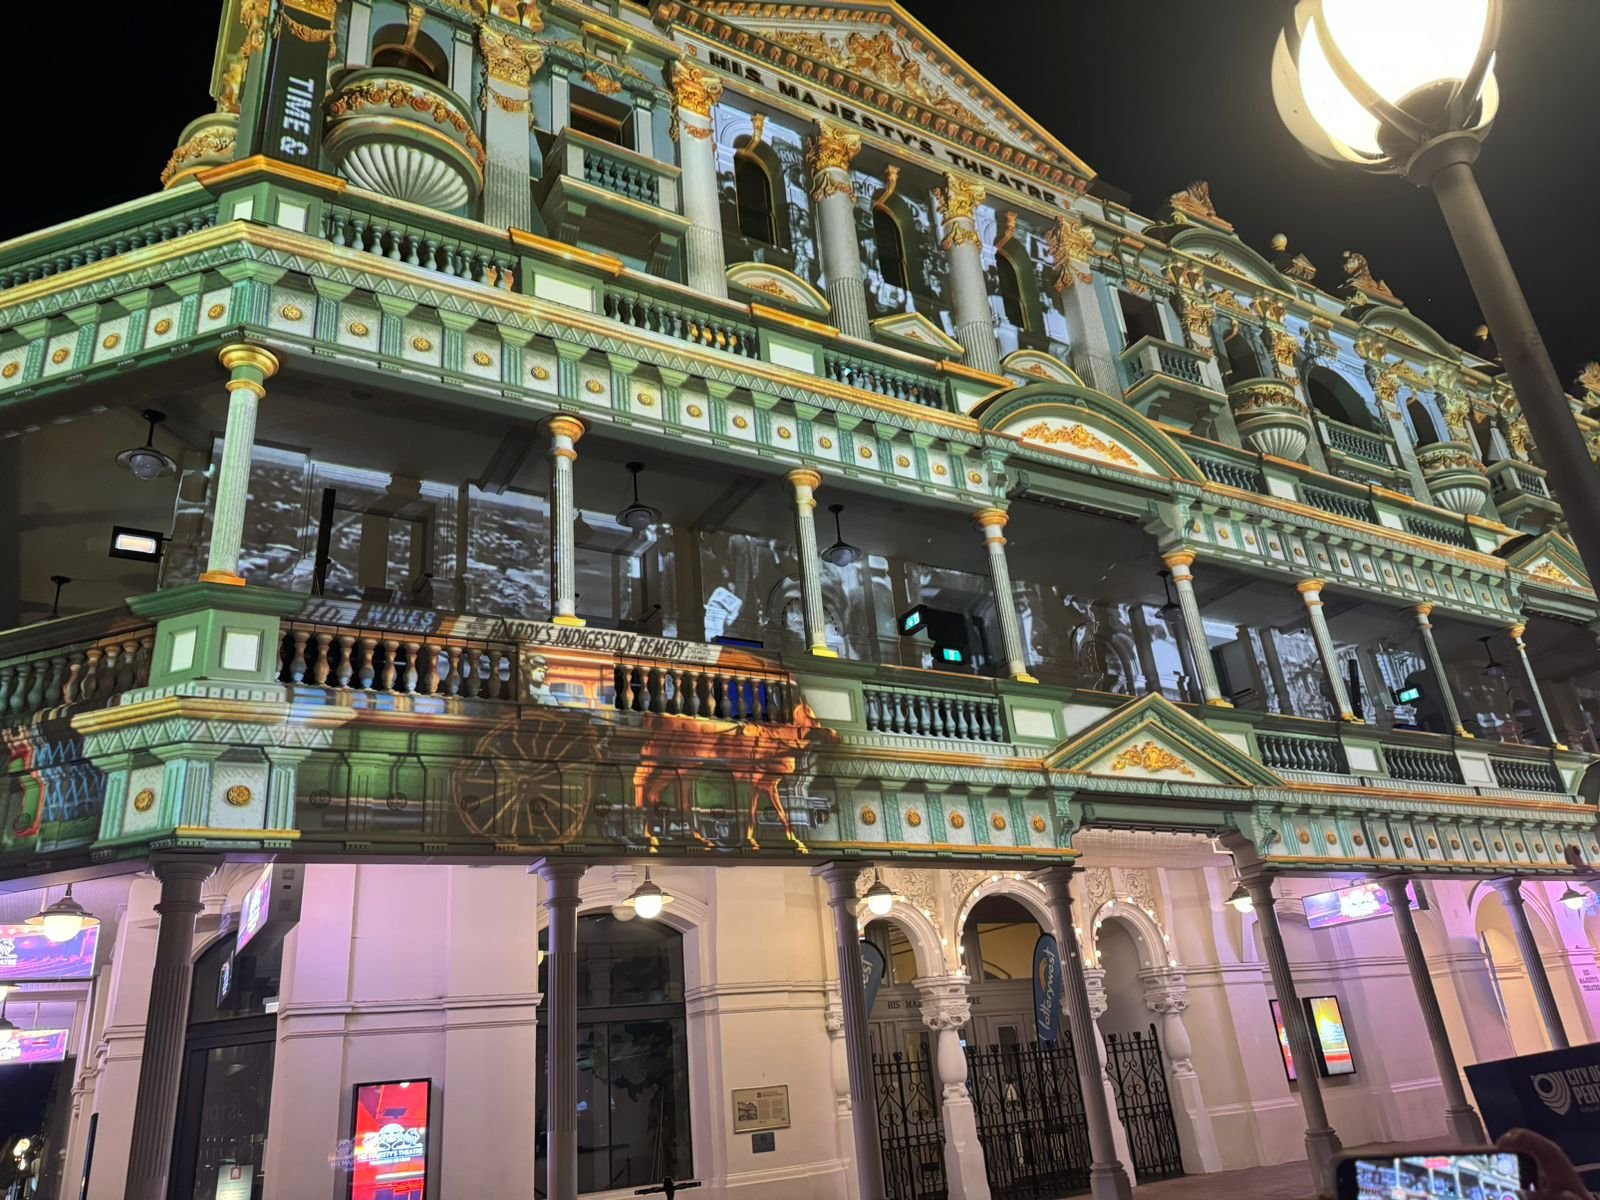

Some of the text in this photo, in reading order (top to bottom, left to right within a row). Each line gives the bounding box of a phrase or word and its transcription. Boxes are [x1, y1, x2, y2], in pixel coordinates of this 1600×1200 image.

[280, 76, 314, 155] TIME &
[708, 51, 1060, 207] HIS MAJESTY'S THEATRE
[367, 604, 436, 627] WINES
[555, 627, 635, 653] INDIGESTION
[635, 637, 689, 658] REMEDY
[1038, 946, 1055, 1030] lotterywest
[887, 1000, 901, 1010] HIS
[1565, 1067, 1589, 1086] CITY
